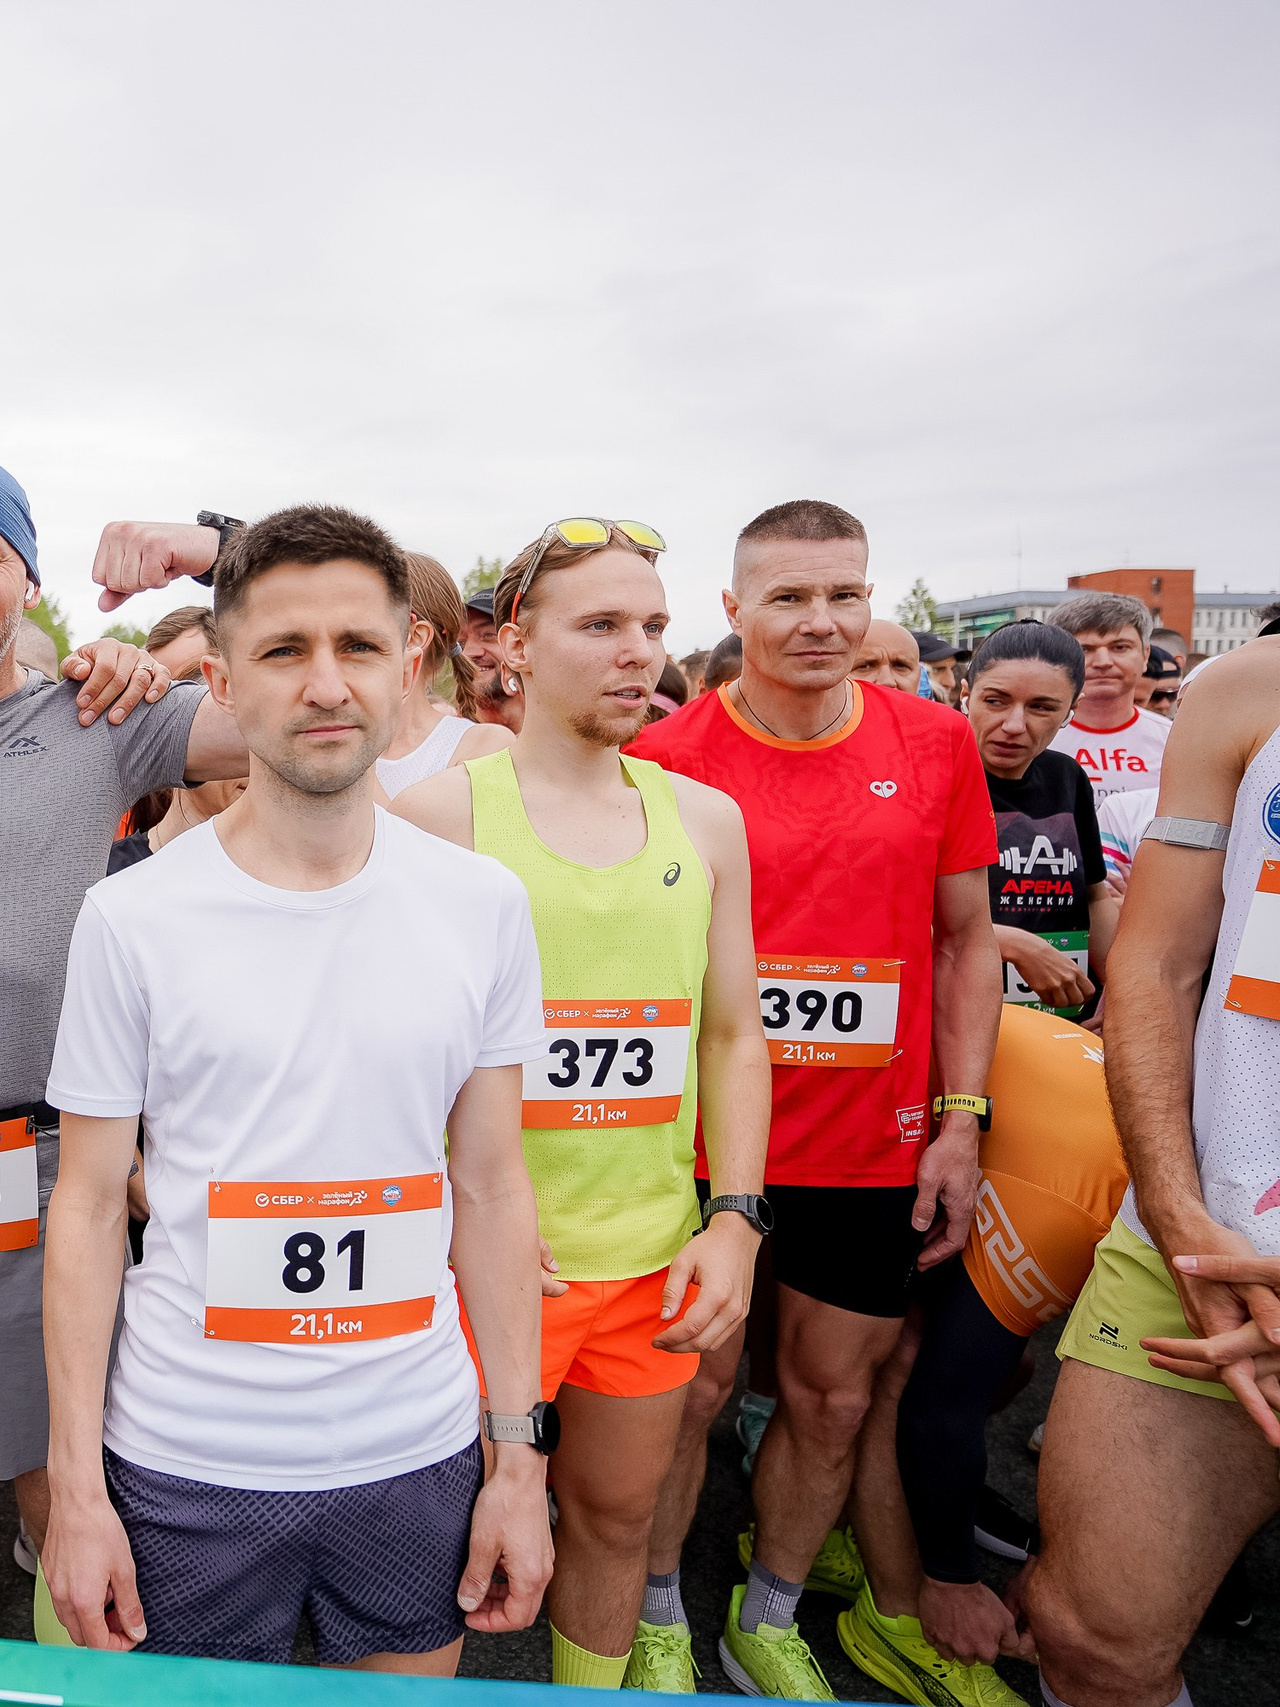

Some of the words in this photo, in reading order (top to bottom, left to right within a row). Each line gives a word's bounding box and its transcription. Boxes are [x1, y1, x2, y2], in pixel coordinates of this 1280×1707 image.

[1075, 748, 1149, 773] Alfa
[1001, 879, 1074, 895] АРЕНА
[1000, 895, 1074, 906] ЖЕНСКИЙ
[769, 963, 793, 971] СБЕР
[556, 1010, 581, 1018] СБЕР
[760, 987, 862, 1032] 390
[547, 1038, 654, 1088] 373
[782, 1043, 814, 1063] 21,1
[572, 1103, 605, 1124] 21,1
[271, 1195, 303, 1205] СБЕР
[282, 1229, 366, 1294] 81
[289, 1313, 334, 1340] 21,1
